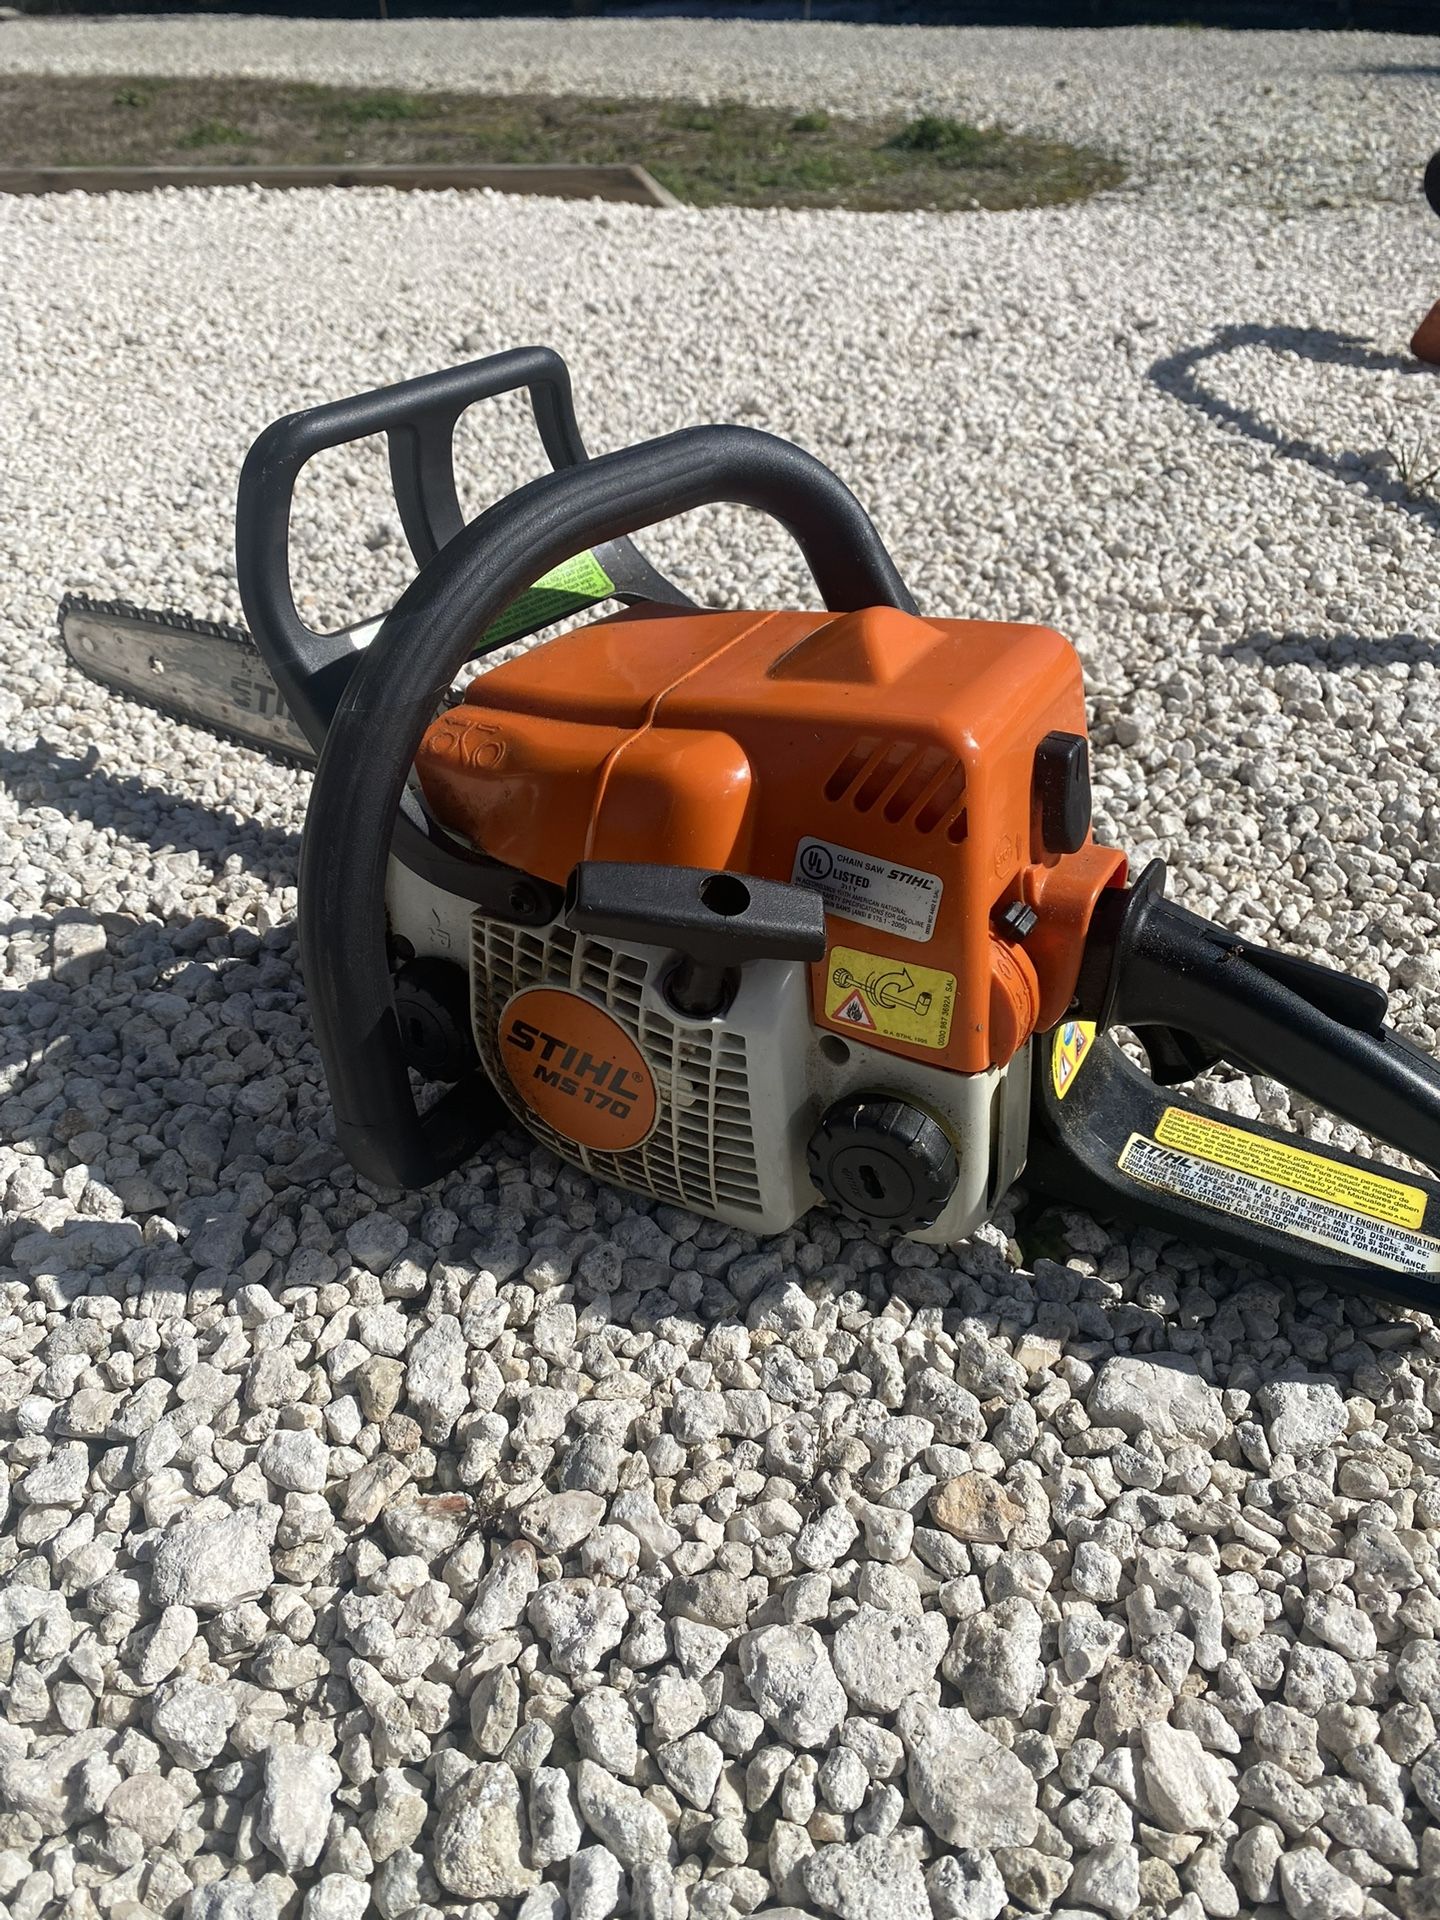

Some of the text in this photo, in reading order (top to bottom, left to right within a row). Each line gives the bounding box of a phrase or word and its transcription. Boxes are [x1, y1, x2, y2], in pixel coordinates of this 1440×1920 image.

[231, 675, 286, 716] STI
[808, 851, 823, 874] UL
[832, 869, 870, 888] LISTED
[836, 853, 884, 875] CHAIN SAW
[841, 897, 884, 916] SPECIFICATIONS
[884, 910, 895, 919] FOR
[896, 914, 924, 928] GASOLINE
[851, 894, 879, 907] AMERICAN
[880, 902, 907, 915] NATIONAL
[533, 1064, 631, 1119] MS 170
[1169, 1108, 1230, 1132] ADVERTENCIA!
[1158, 1132, 1197, 1150] Seguridad
[1197, 1147, 1212, 1155] que
[1224, 1155, 1258, 1171] entregan
[1260, 1167, 1291, 1181] escritos
[1160, 1127, 1175, 1135] leer
[1182, 1135, 1202, 1145] tener
[1214, 1146, 1240, 1158] cuenta
[1250, 1158, 1279, 1171] Manual
[1280, 1168, 1292, 1176] del
[1294, 1173, 1325, 1187] Usuario
[1333, 1186, 1345, 1194] los
[1347, 1190, 1386, 1208] Manuales
[1387, 1204, 1399, 1212] de
[1165, 1118, 1190, 1130] graves
[1221, 1137, 1235, 1145] usa
[1248, 1146, 1270, 1157] forma
[1333, 1174, 1360, 1187] reducir
[1371, 1187, 1396, 1200] riesgo
[1398, 1196, 1409, 1204] de
[1185, 1119, 1211, 1131] unidad
[1211, 1128, 1236, 1140] puede
[1250, 1141, 1287, 1158] peligrosa
[1293, 1155, 1325, 1169] producir
[1326, 1166, 1359, 1181] lesiones
[1360, 1177, 1405, 1196] personales
[1123, 1156, 1167, 1180] COMPLIANCE
[1197, 1186, 1234, 1204] CATEGORY
[1245, 1202, 1269, 1216] REFER
[1271, 1211, 1281, 1220] TO
[1282, 1215, 1317, 1233] OWNER'S
[1318, 1228, 1350, 1245] MANUAL
[1352, 1239, 1368, 1251] FOR
[1126, 1151, 1143, 1163] THIS
[1143, 1159, 1169, 1174] ENGINE
[1170, 1169, 1194, 1182] MEETS
[1212, 1184, 1226, 1194] EPA
[1227, 1189, 1251, 1203] PHASE
[1260, 1200, 1295, 1218] EMISSION
[1297, 1213, 1349, 1237] REGULATIONS
[1350, 1231, 1366, 1242] FOR
[1368, 1237, 1375, 1246] SI
[1128, 1145, 1157, 1162] ENGINE
[1333, 1219, 1346, 1228] MS
[1403, 1242, 1414, 1253] 30
[1132, 1139, 1192, 1169] STIHL
[1198, 1162, 1236, 1183] ANDREAS
[1235, 1175, 1258, 1191] STIHL
[1259, 1183, 1272, 1195] AG
[1272, 1188, 1280, 1198] &
[1280, 1190, 1293, 1203] Co.
[1356, 1216, 1384, 1234] ENGINE
[1386, 1227, 1440, 1252] INFORMATION
[1179, 1186, 1231, 1210] ADJUSTMENTS
[1232, 1205, 1249, 1216] AND
[1276, 1161, 1316, 1179] ayudantes
[1324, 1177, 1336, 1185] los
[1337, 1181, 1391, 1205] espectadores
[1393, 1200, 1419, 1213] deben
